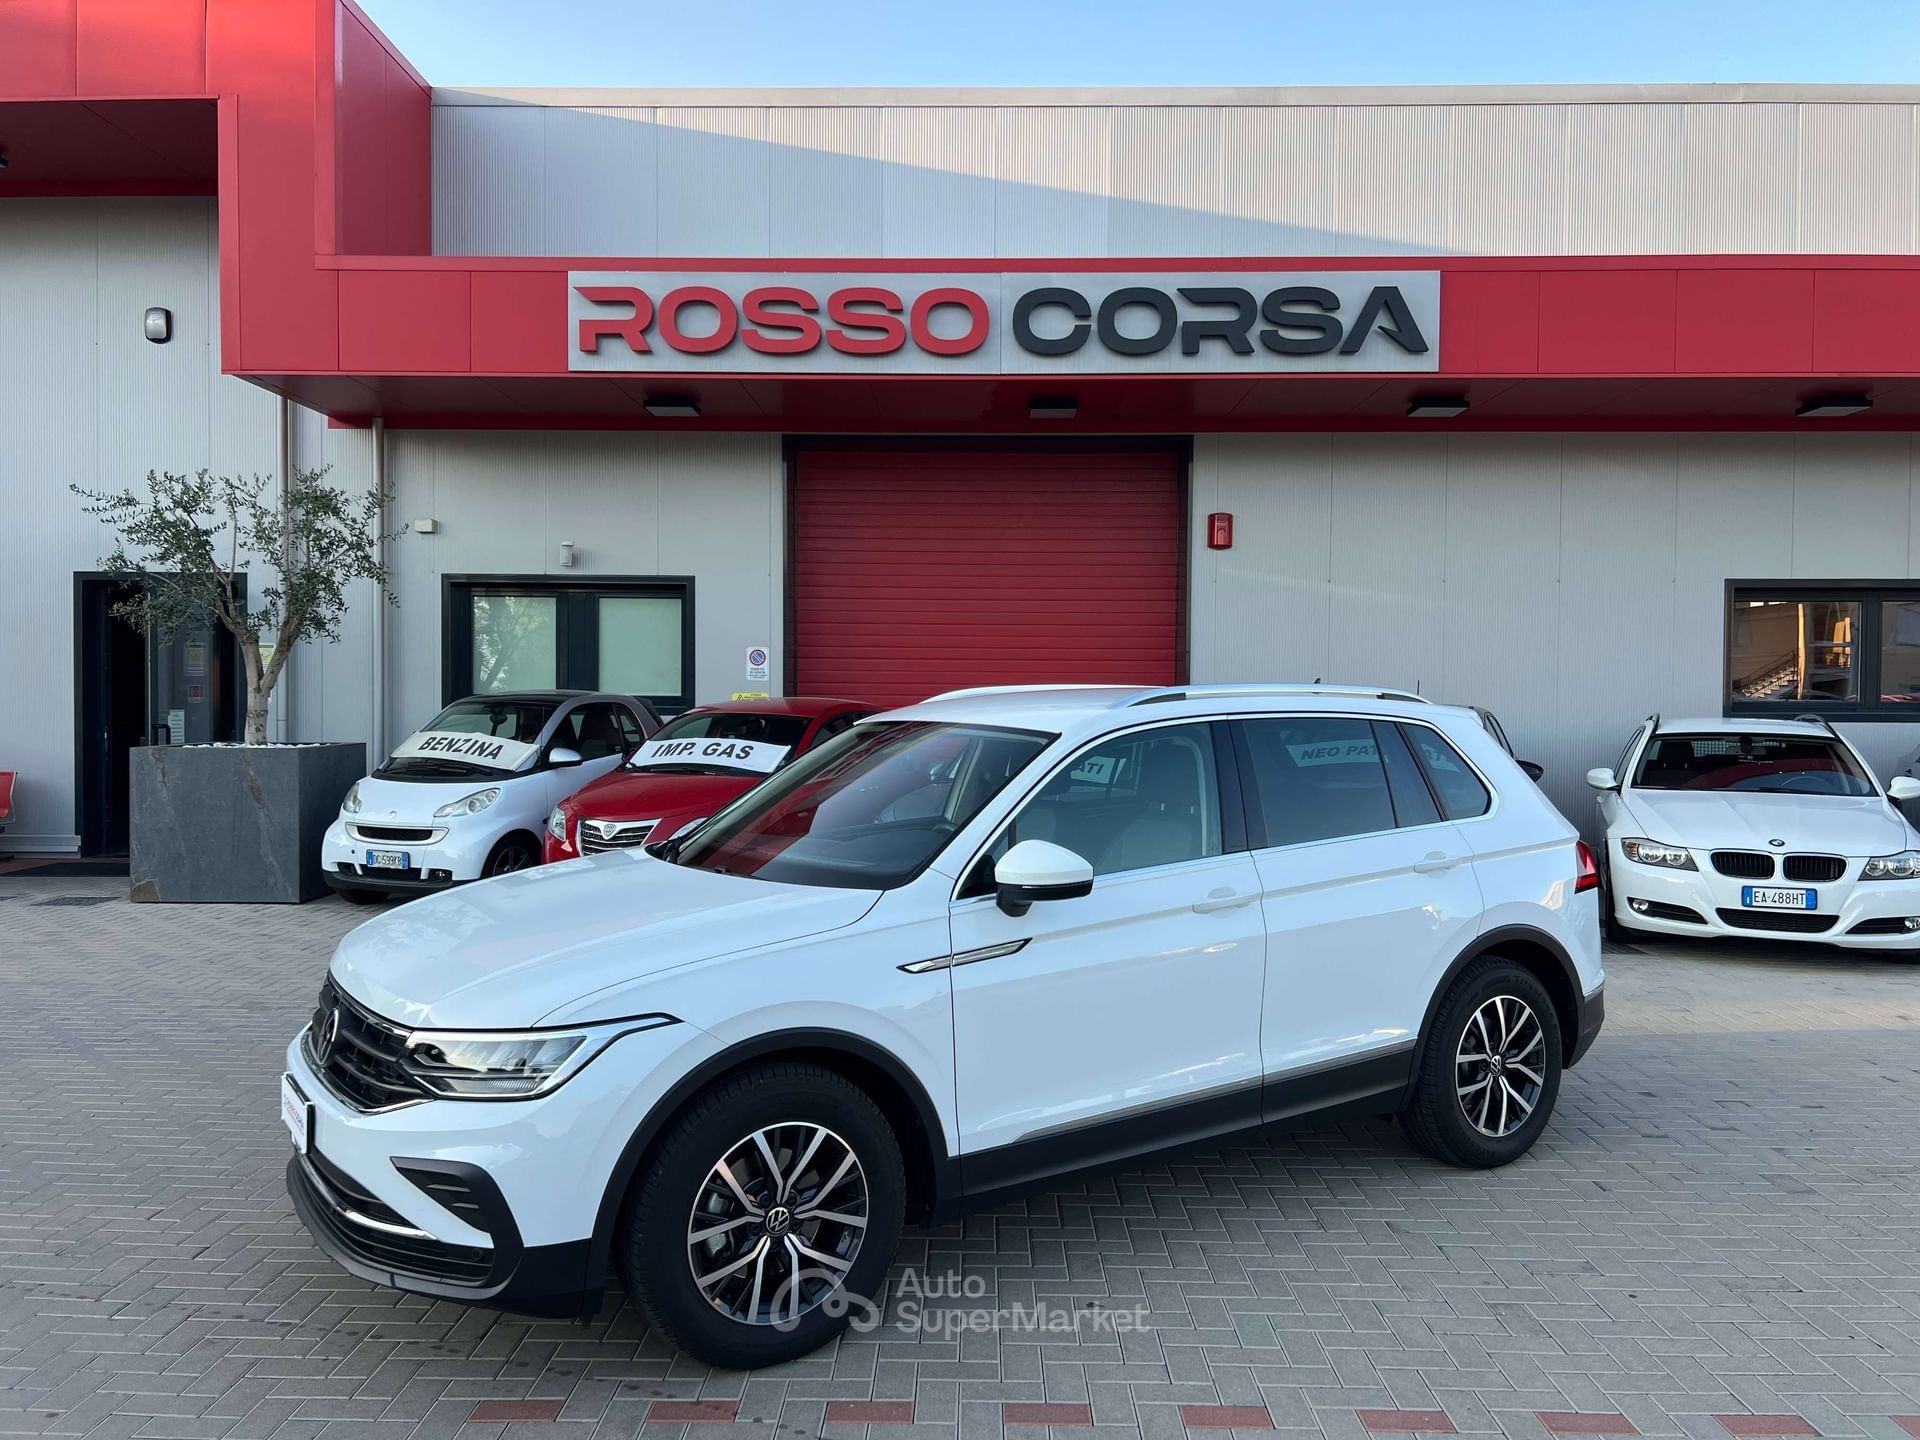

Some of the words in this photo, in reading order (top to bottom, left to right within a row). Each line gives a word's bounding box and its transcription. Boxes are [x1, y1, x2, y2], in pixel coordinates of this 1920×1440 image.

[573, 286, 990, 356] ROSSO
[1012, 286, 1430, 358] CORSA
[417, 737, 504, 759] BENZINA
[651, 742, 696, 758] IMP.
[702, 742, 754, 759] GAS
[1301, 746, 1340, 761] NEO
